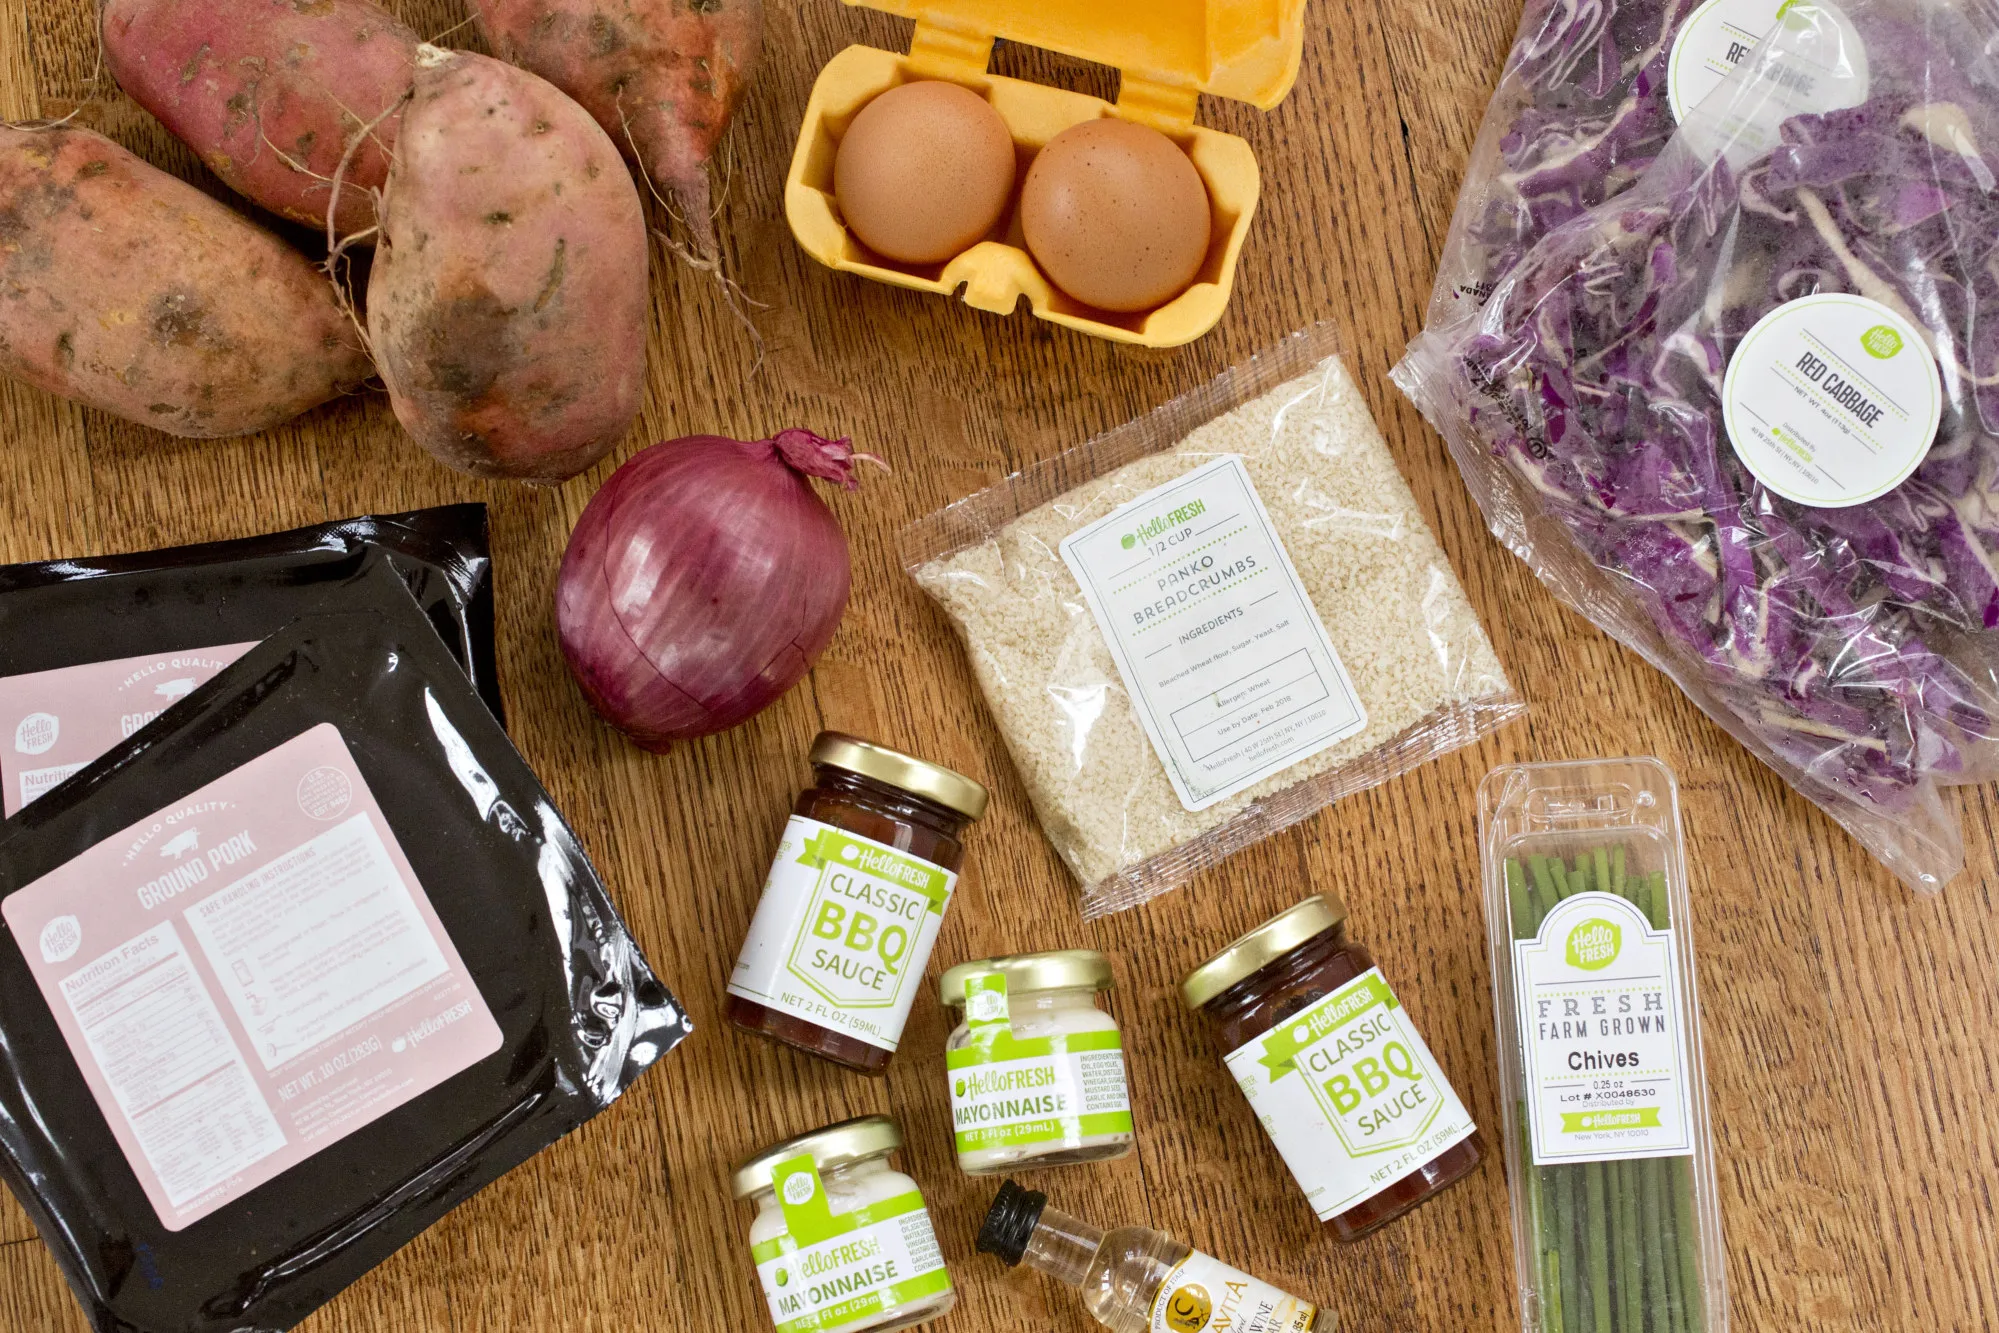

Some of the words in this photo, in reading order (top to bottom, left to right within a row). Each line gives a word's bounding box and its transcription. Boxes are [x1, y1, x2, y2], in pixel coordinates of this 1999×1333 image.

[1726, 42, 1751, 65] RE
[1794, 386, 1808, 399] NET
[1809, 398, 1821, 411] WT.
[1796, 351, 1825, 383] RED
[1823, 374, 1884, 428] CABBAGE
[1137, 499, 1207, 549] HelloFRESH
[1149, 540, 1168, 557] 1/2
[1167, 527, 1193, 548] CUP
[1133, 555, 1257, 625] BREADCRUMBS
[1157, 555, 1215, 592] PANKO
[1178, 606, 1244, 645] INGREDIENTS
[1158, 669, 1190, 689] Bleached
[1190, 657, 1213, 673] Wheat
[1231, 638, 1255, 652] Sugar,
[1275, 619, 1290, 631] Salt
[124, 661, 167, 688] HELLO
[171, 657, 230, 670] QUALIT
[1247, 678, 1271, 693] Wheat
[20, 719, 52, 743] Hello
[1217, 725, 1231, 736] Use
[1231, 720, 1241, 730] by
[1260, 703, 1275, 714] Feb
[1275, 695, 1292, 708] 2018
[26, 730, 53, 750] FRESH
[24, 769, 77, 786] Nutritio
[125, 824, 163, 861] HELLO
[166, 801, 228, 825] QUALITY
[137, 857, 209, 910] GROUND
[207, 829, 258, 872] PORK
[860, 849, 931, 889] HelloFRESH
[830, 873, 920, 921] CLASSIC
[45, 920, 74, 949] Hello
[51, 931, 78, 958] FRESH
[812, 900, 908, 976] BBQ
[1571, 925, 1614, 949] Hello
[65, 948, 120, 994] Nutrition
[121, 934, 160, 961] Facts
[811, 949, 887, 991] SAUCE
[1579, 941, 1616, 965] FRESH
[780, 991, 804, 1008] NET
[805, 999, 814, 1013] 2
[814, 1004, 828, 1018] FL
[831, 1009, 847, 1025] OZ
[849, 1014, 881, 1037] (59ML)
[1309, 986, 1374, 1037] HelloFRESH
[1537, 992, 1663, 1019] FRESH
[407, 1000, 473, 1048] HelloFRESH
[1539, 1019, 1588, 1041] FARM
[1600, 1014, 1666, 1037] GROWN
[1309, 1013, 1392, 1073] CLASSIC
[1568, 1050, 1640, 1071] Chives
[278, 1082, 301, 1103] NET
[321, 1063, 335, 1081] 10
[967, 1065, 1056, 1101] HelloFRESH
[1322, 1041, 1423, 1116] BBQ
[1593, 1080, 1611, 1090] 0.25
[955, 1093, 1068, 1126] MAYONNAISE
[1357, 1083, 1427, 1136] SAUCE
[1560, 1094, 1581, 1102] Lot
[1583, 1092, 1592, 1100] #
[1582, 1098, 1624, 1108] Distributed
[1625, 1097, 1635, 1106] by
[964, 1132, 978, 1142] NET
[999, 1127, 1012, 1138] oz
[1015, 1121, 1055, 1137] (29mL)
[1574, 1133, 1592, 1141] New
[1594, 1132, 1613, 1140] York,
[1613, 1130, 1625, 1138] NY
[1627, 1129, 1649, 1137] 10010
[1592, 1111, 1642, 1128] HelloFRESH
[1370, 1166, 1394, 1185] NET
[1394, 1158, 1404, 1171] 2
[1403, 1150, 1417, 1165] FL
[1416, 1140, 1433, 1158] OZ
[1432, 1122, 1462, 1149] (59ML)
[787, 1177, 809, 1194] Hello
[794, 1236, 881, 1279] elloFRESH
[778, 1260, 898, 1316] MAYONNAISE
[1154, 1296, 1167, 1330] PRODUCT
[1163, 1285, 1172, 1295] OF
[1170, 1268, 1185, 1285] ITALY
[835, 1305, 849, 1316] oz
[1249, 1300, 1274, 1333] WINE
